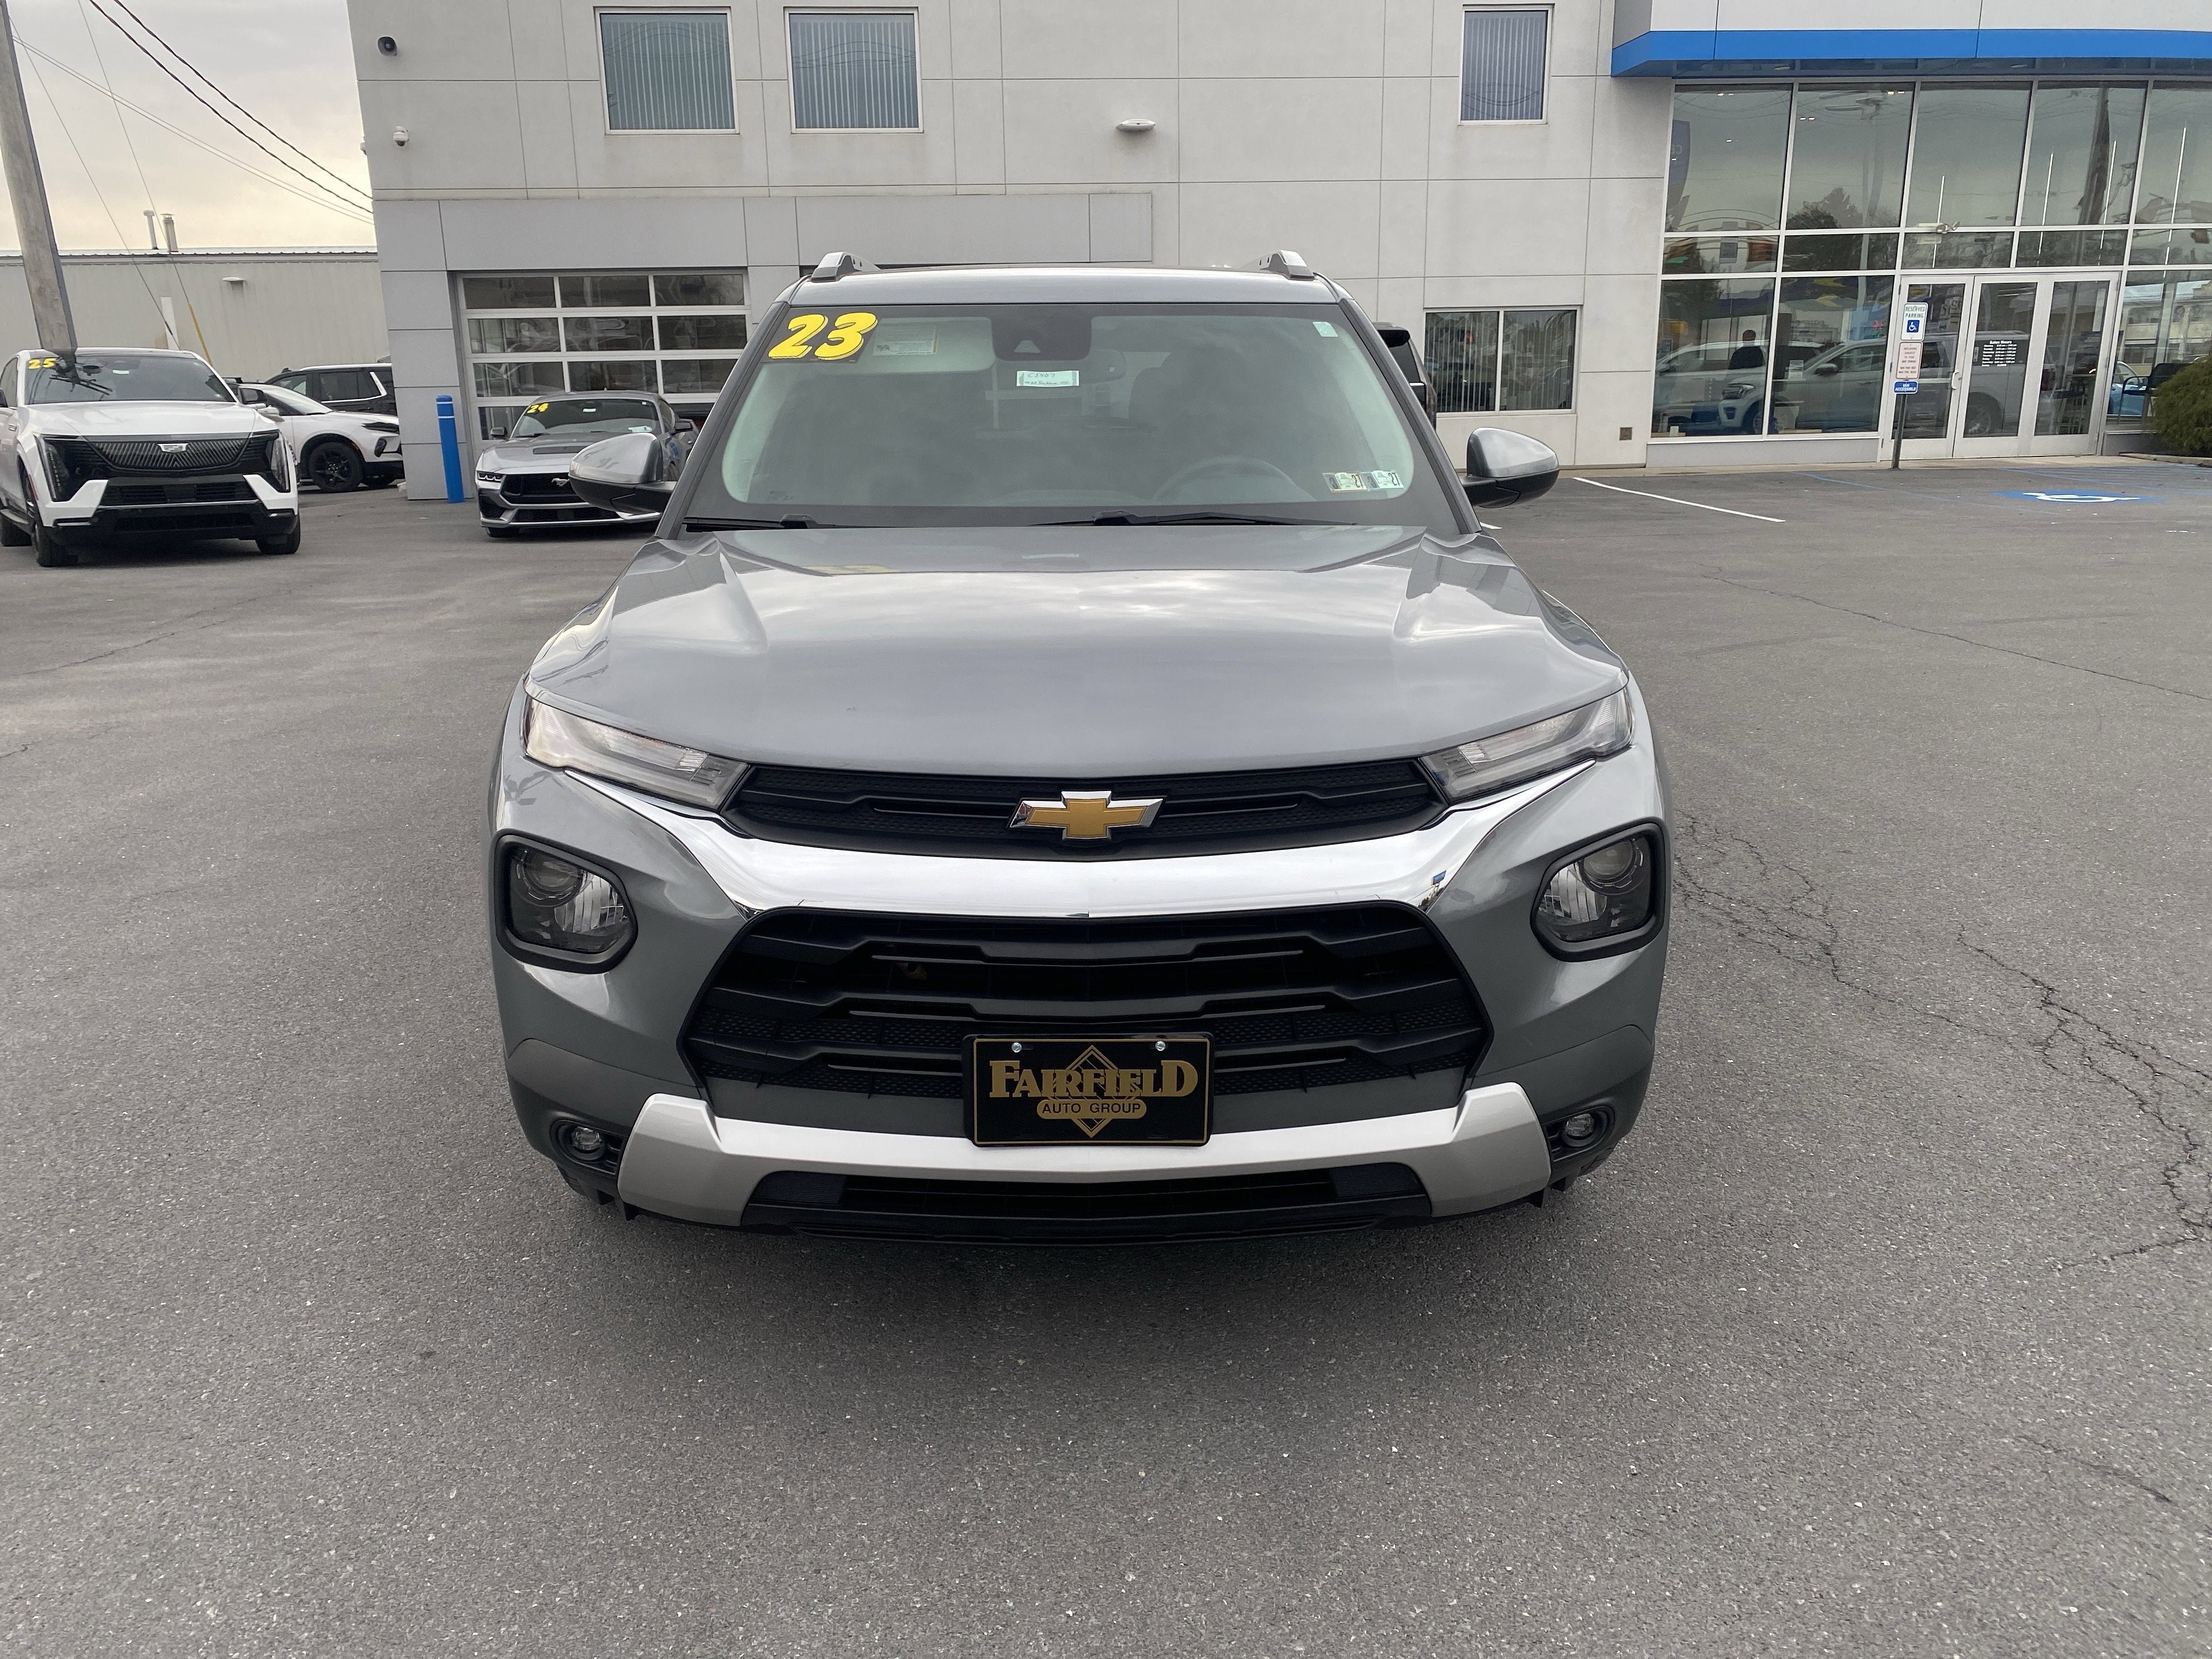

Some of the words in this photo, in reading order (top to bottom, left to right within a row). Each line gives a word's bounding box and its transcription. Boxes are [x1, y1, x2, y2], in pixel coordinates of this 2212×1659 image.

[768, 312, 878, 360] 23
[29, 358, 56, 369] 25
[527, 403, 549, 414] 24
[989, 1060, 1198, 1097] FAIRFIELD
[1042, 1103, 1081, 1114] AUTO
[1090, 1103, 1141, 1114] GROUP
